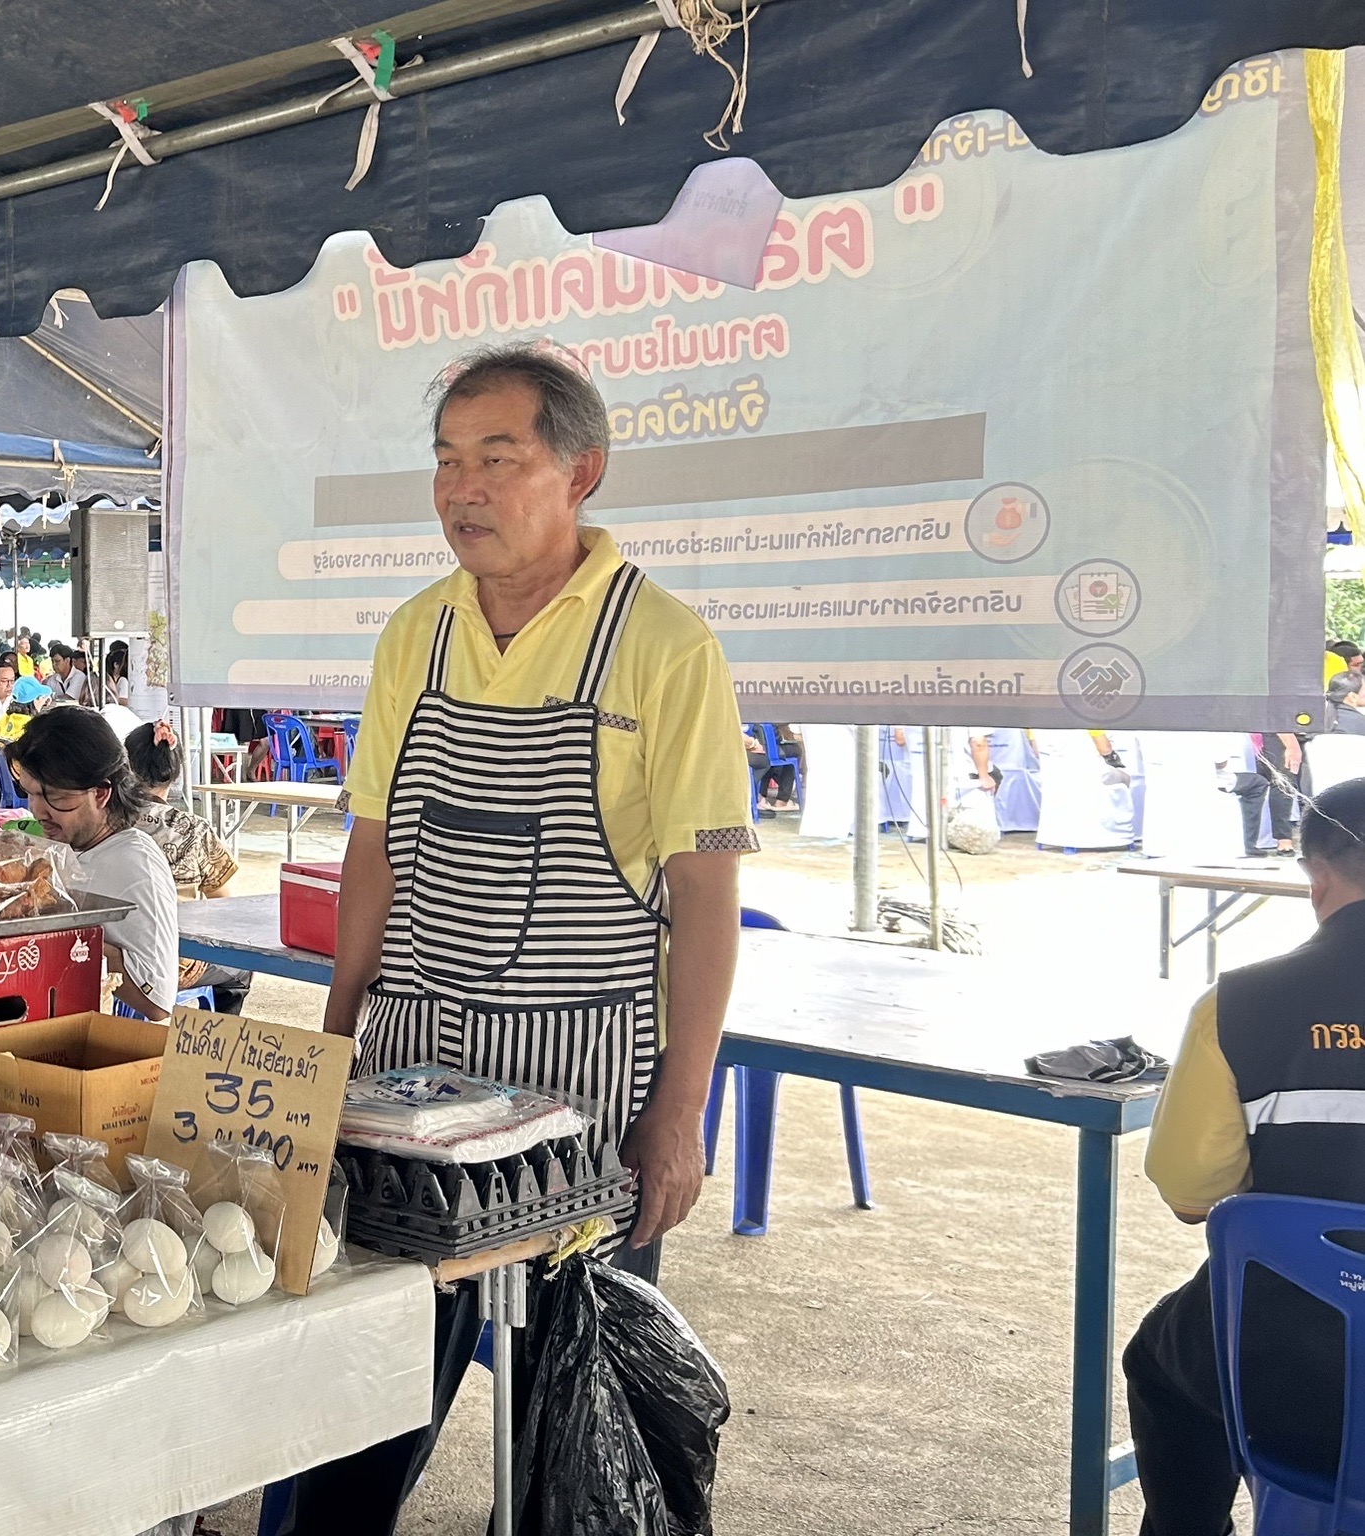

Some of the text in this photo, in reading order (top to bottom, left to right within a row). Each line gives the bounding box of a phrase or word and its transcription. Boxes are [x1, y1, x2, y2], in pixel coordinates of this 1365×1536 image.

[20, 1088, 40, 1108] ฟอง
[205, 1072, 274, 1119] 35
[172, 1111, 198, 1143] 3
